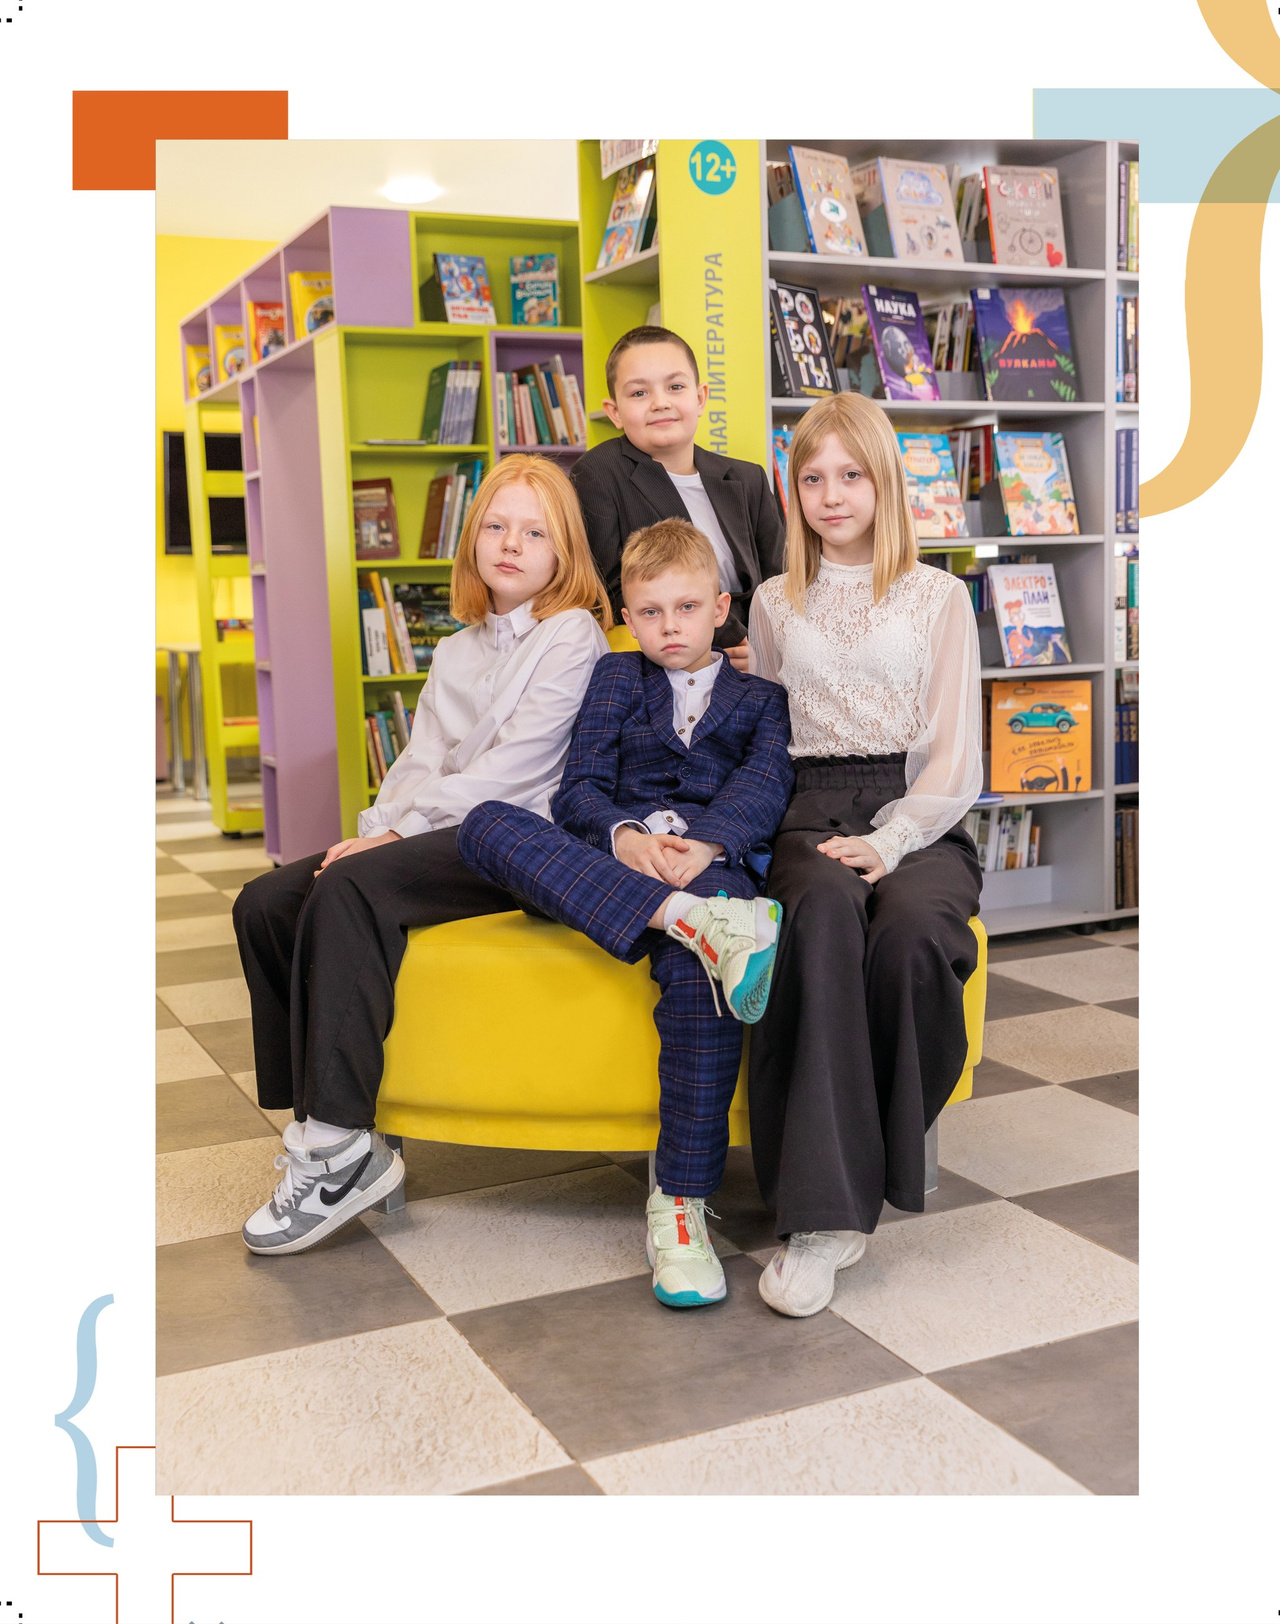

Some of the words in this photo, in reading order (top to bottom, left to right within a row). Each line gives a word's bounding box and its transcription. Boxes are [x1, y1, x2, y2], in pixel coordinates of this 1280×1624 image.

[691, 151, 736, 182] 12+
[874, 297, 917, 318] НАУКА
[704, 252, 726, 403] ЛИТЕРАТУРА
[999, 358, 1057, 369] ВУЛКАНЫ
[1003, 574, 1048, 592] ЭЛЕКТРО
[1022, 590, 1050, 606] ПЛАН
